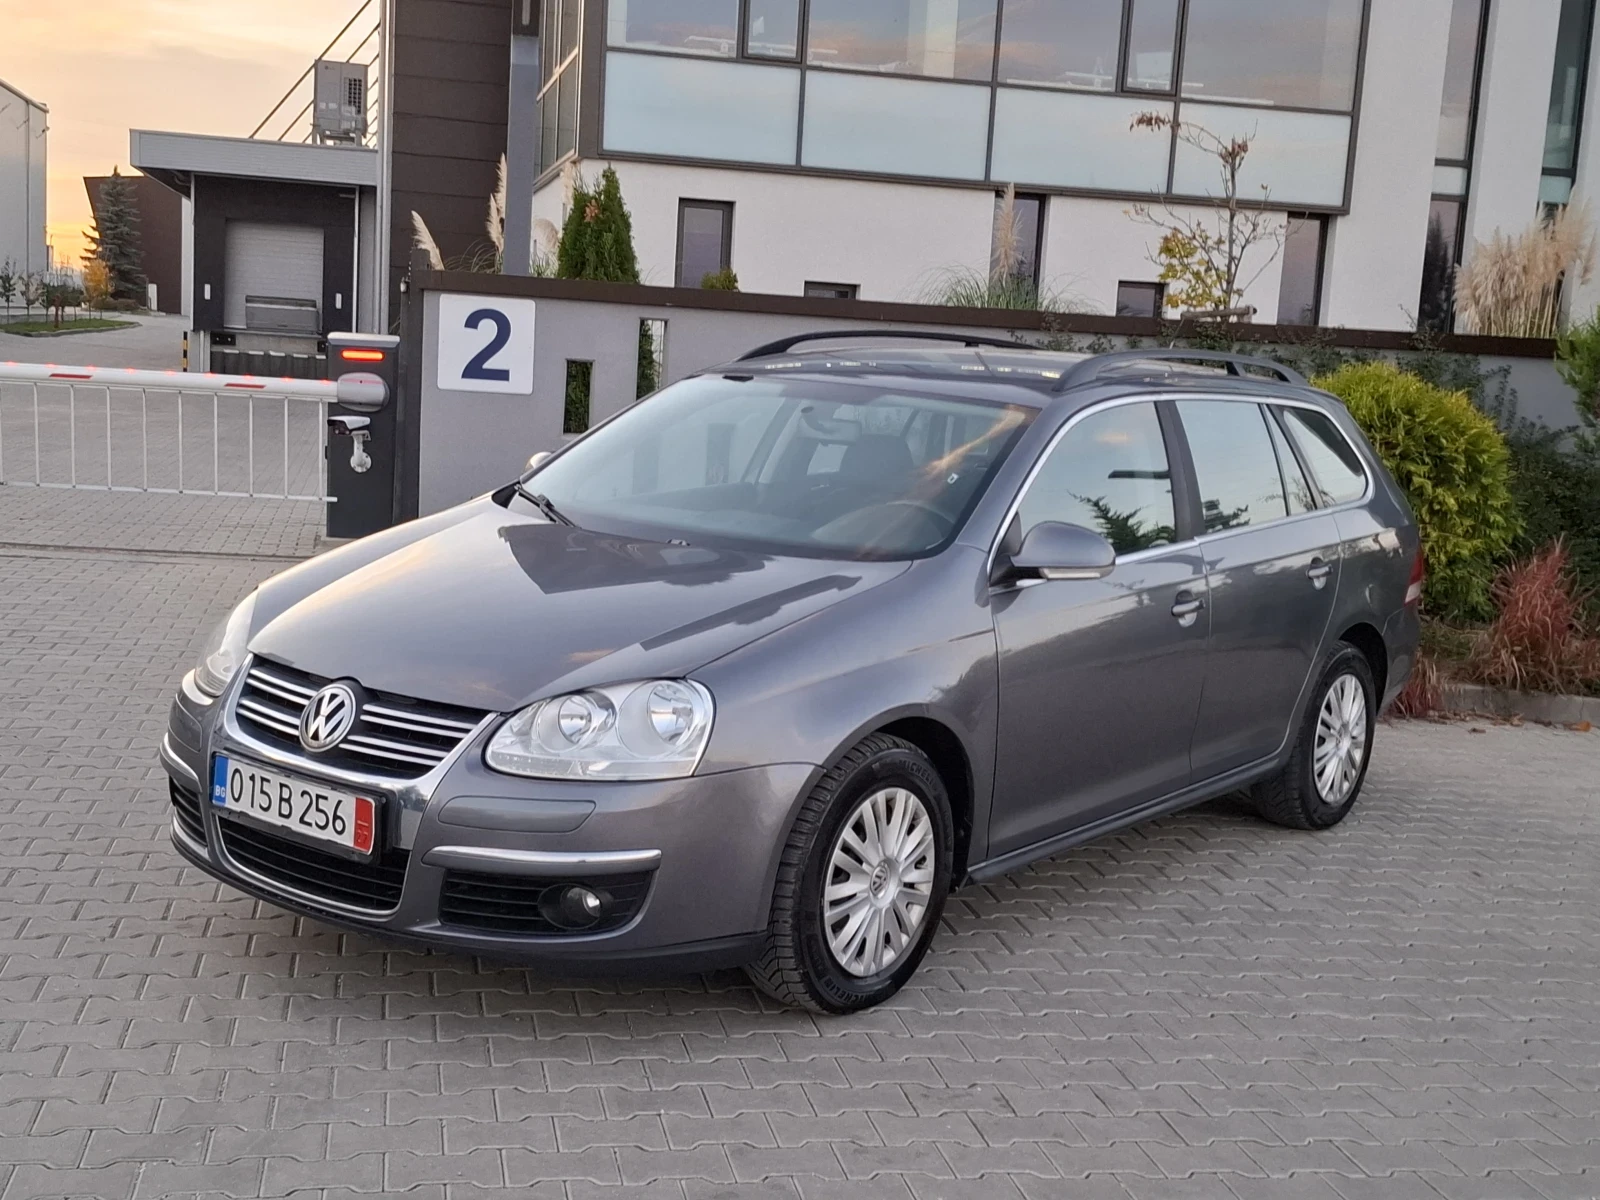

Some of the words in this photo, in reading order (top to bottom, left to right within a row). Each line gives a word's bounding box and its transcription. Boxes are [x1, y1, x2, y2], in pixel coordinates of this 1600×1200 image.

[461, 308, 511, 382] 2
[301, 685, 354, 750] VW
[215, 784, 226, 797] BG
